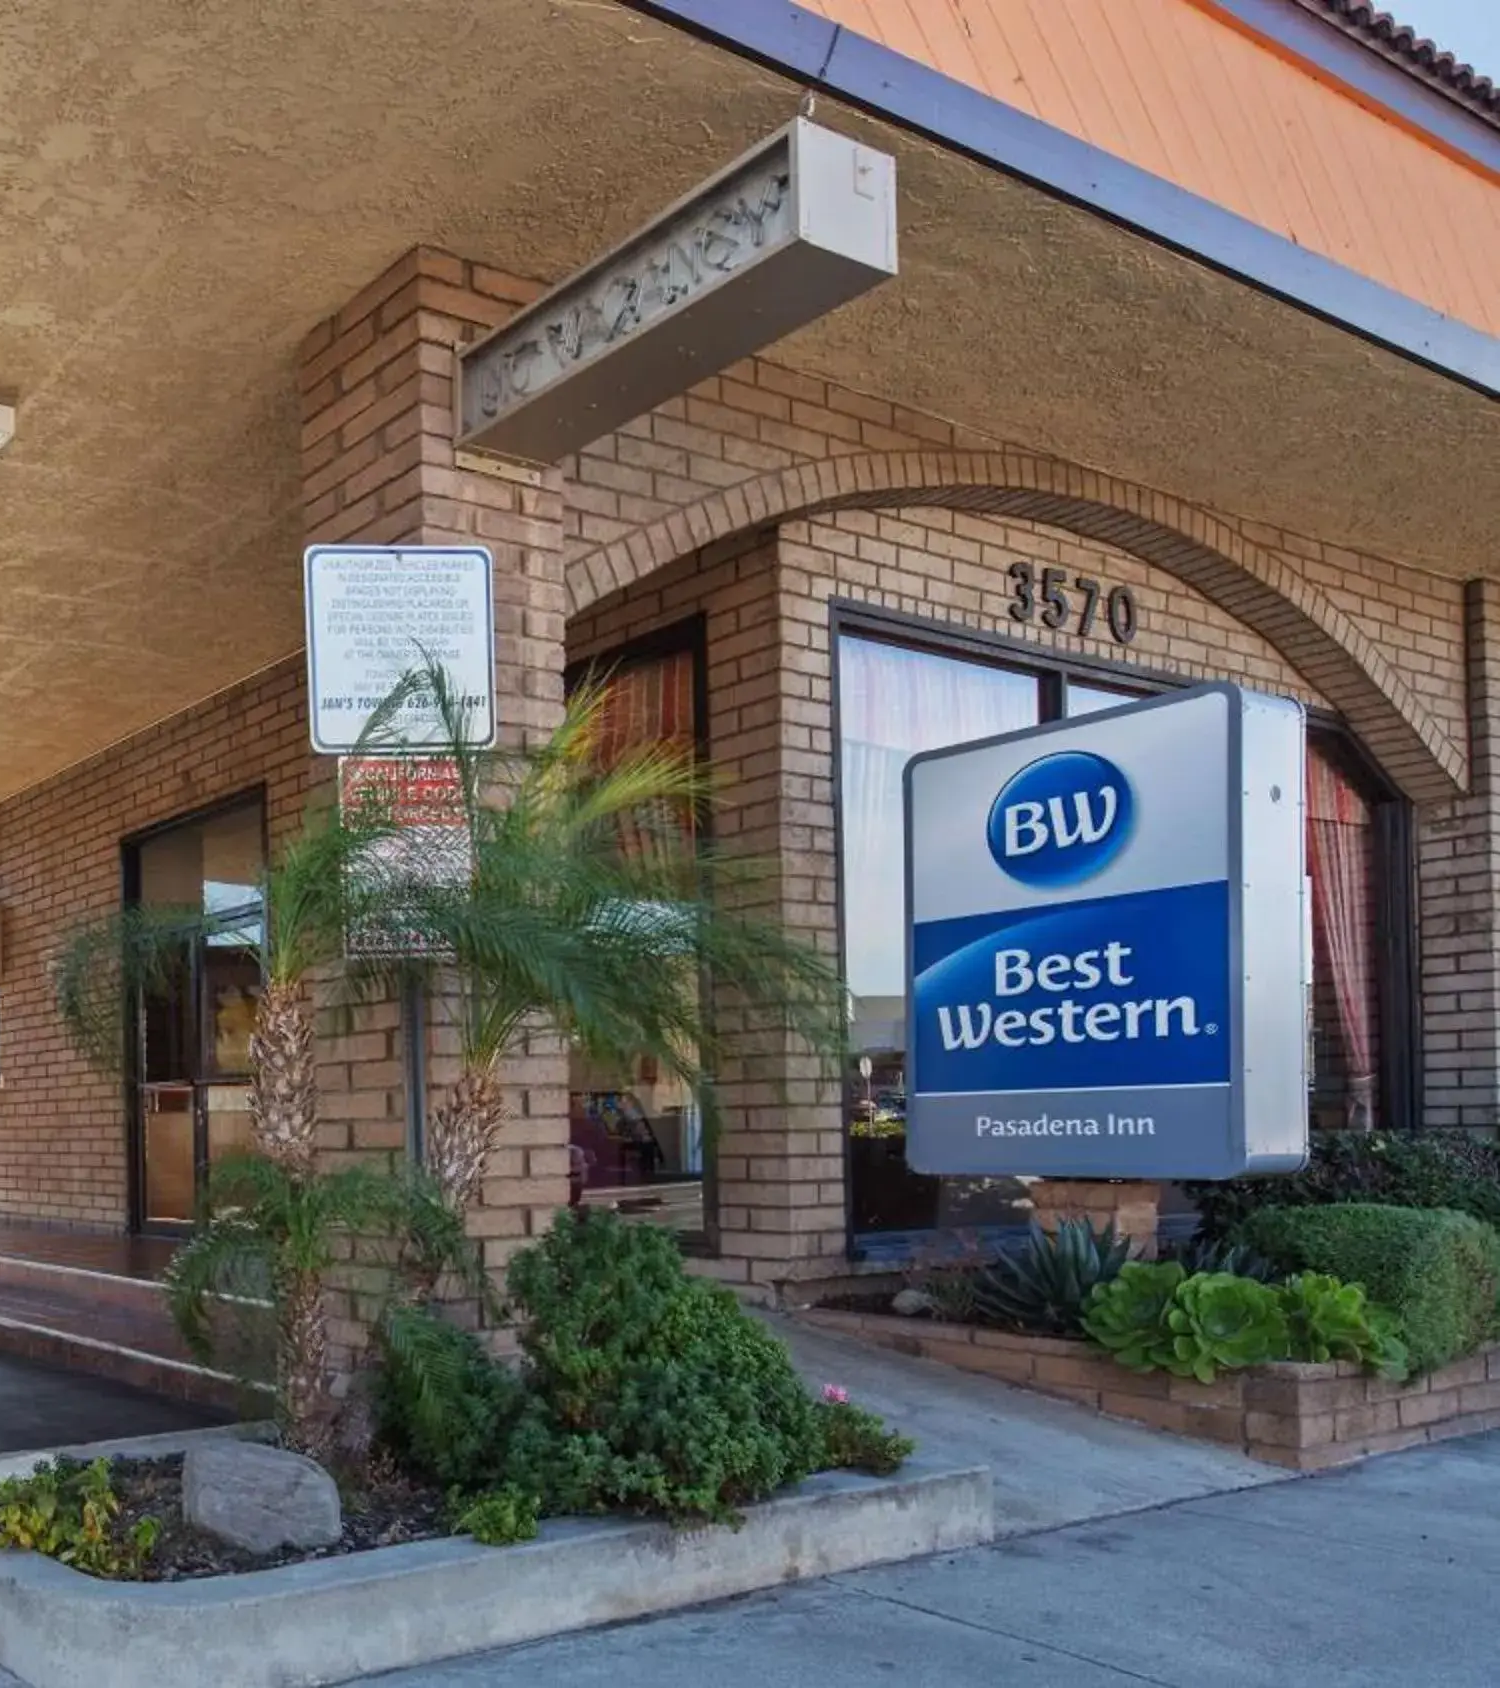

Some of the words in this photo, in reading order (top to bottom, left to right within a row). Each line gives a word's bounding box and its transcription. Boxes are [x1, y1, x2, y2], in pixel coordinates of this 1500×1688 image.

[1008, 561, 1138, 645] 3570
[1004, 785, 1117, 858] BW
[994, 941, 1135, 997] Best
[937, 995, 1200, 1052] Western
[976, 1115, 1100, 1138] Pasadena
[1107, 1113, 1156, 1137] Inn
